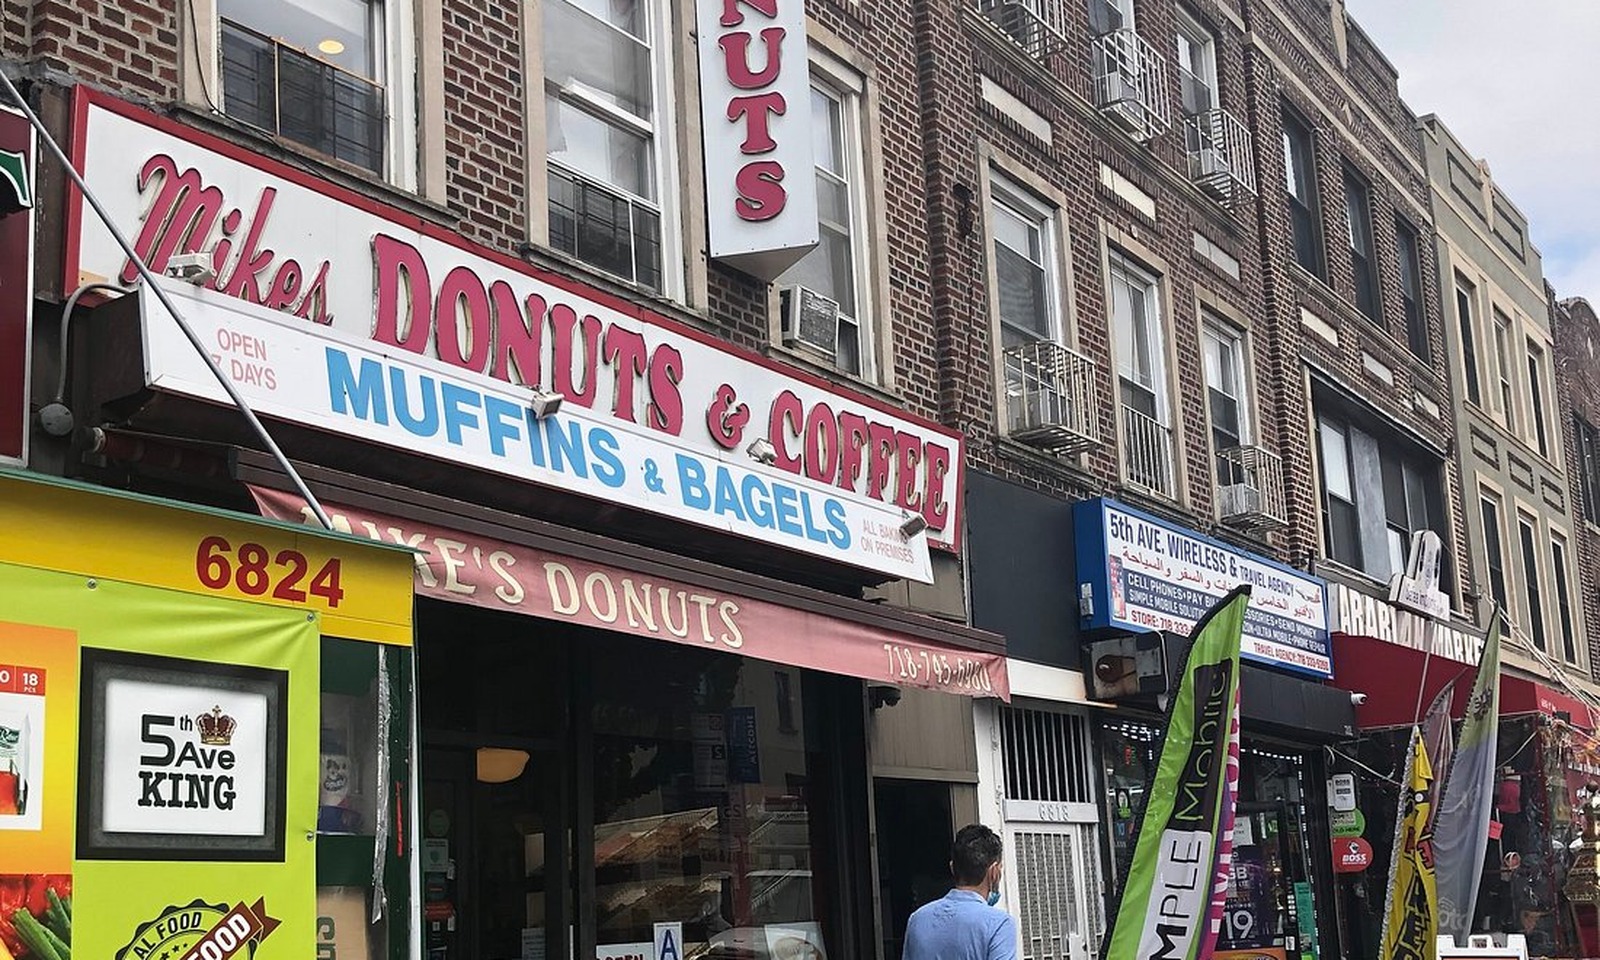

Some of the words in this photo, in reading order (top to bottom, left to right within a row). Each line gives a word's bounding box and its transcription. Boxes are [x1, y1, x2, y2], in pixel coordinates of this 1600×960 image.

[119, 154, 333, 327] Mikes
[371, 233, 684, 436] DONUTS
[707, 383, 750, 449] &
[768, 389, 951, 531] COFFEE
[217, 327, 268, 361] OPEN
[231, 360, 277, 391] DAYS
[325, 346, 626, 488] MUFFINS
[643, 457, 665, 494] &
[675, 453, 852, 551] BAGELS
[863, 519, 878, 537] ALL
[860, 538, 874, 552] ON
[875, 541, 915, 564] PREMISES
[1110, 512, 1134, 544] 5th
[1167, 533, 1227, 574] WIRELESS
[1229, 556, 1239, 578] &
[1239, 565, 1267, 588] TRAVEL
[1267, 575, 1294, 598] AGENCY
[195, 535, 345, 608] 6824
[1127, 573, 1149, 590] CELL
[544, 562, 744, 649] DONUTS
[1129, 588, 1154, 607] SIMPLE
[1154, 596, 1178, 613] MOBILE
[1131, 609, 1159, 629] STORE:
[1159, 617, 1173, 631] 718
[1295, 622, 1317, 639] MONEY
[1339, 583, 1426, 652] ARABIAN
[1431, 619, 1485, 667] MARKE
[1254, 641, 1275, 657] TRAVEL
[23, 672, 39, 686] 18
[174, 741, 236, 770] Ave
[1174, 671, 1226, 822] Mobile
[137, 770, 237, 811] KING
[1342, 853, 1367, 862] BOSS
[156, 911, 203, 940] FOOD
[660, 928, 679, 960] A
